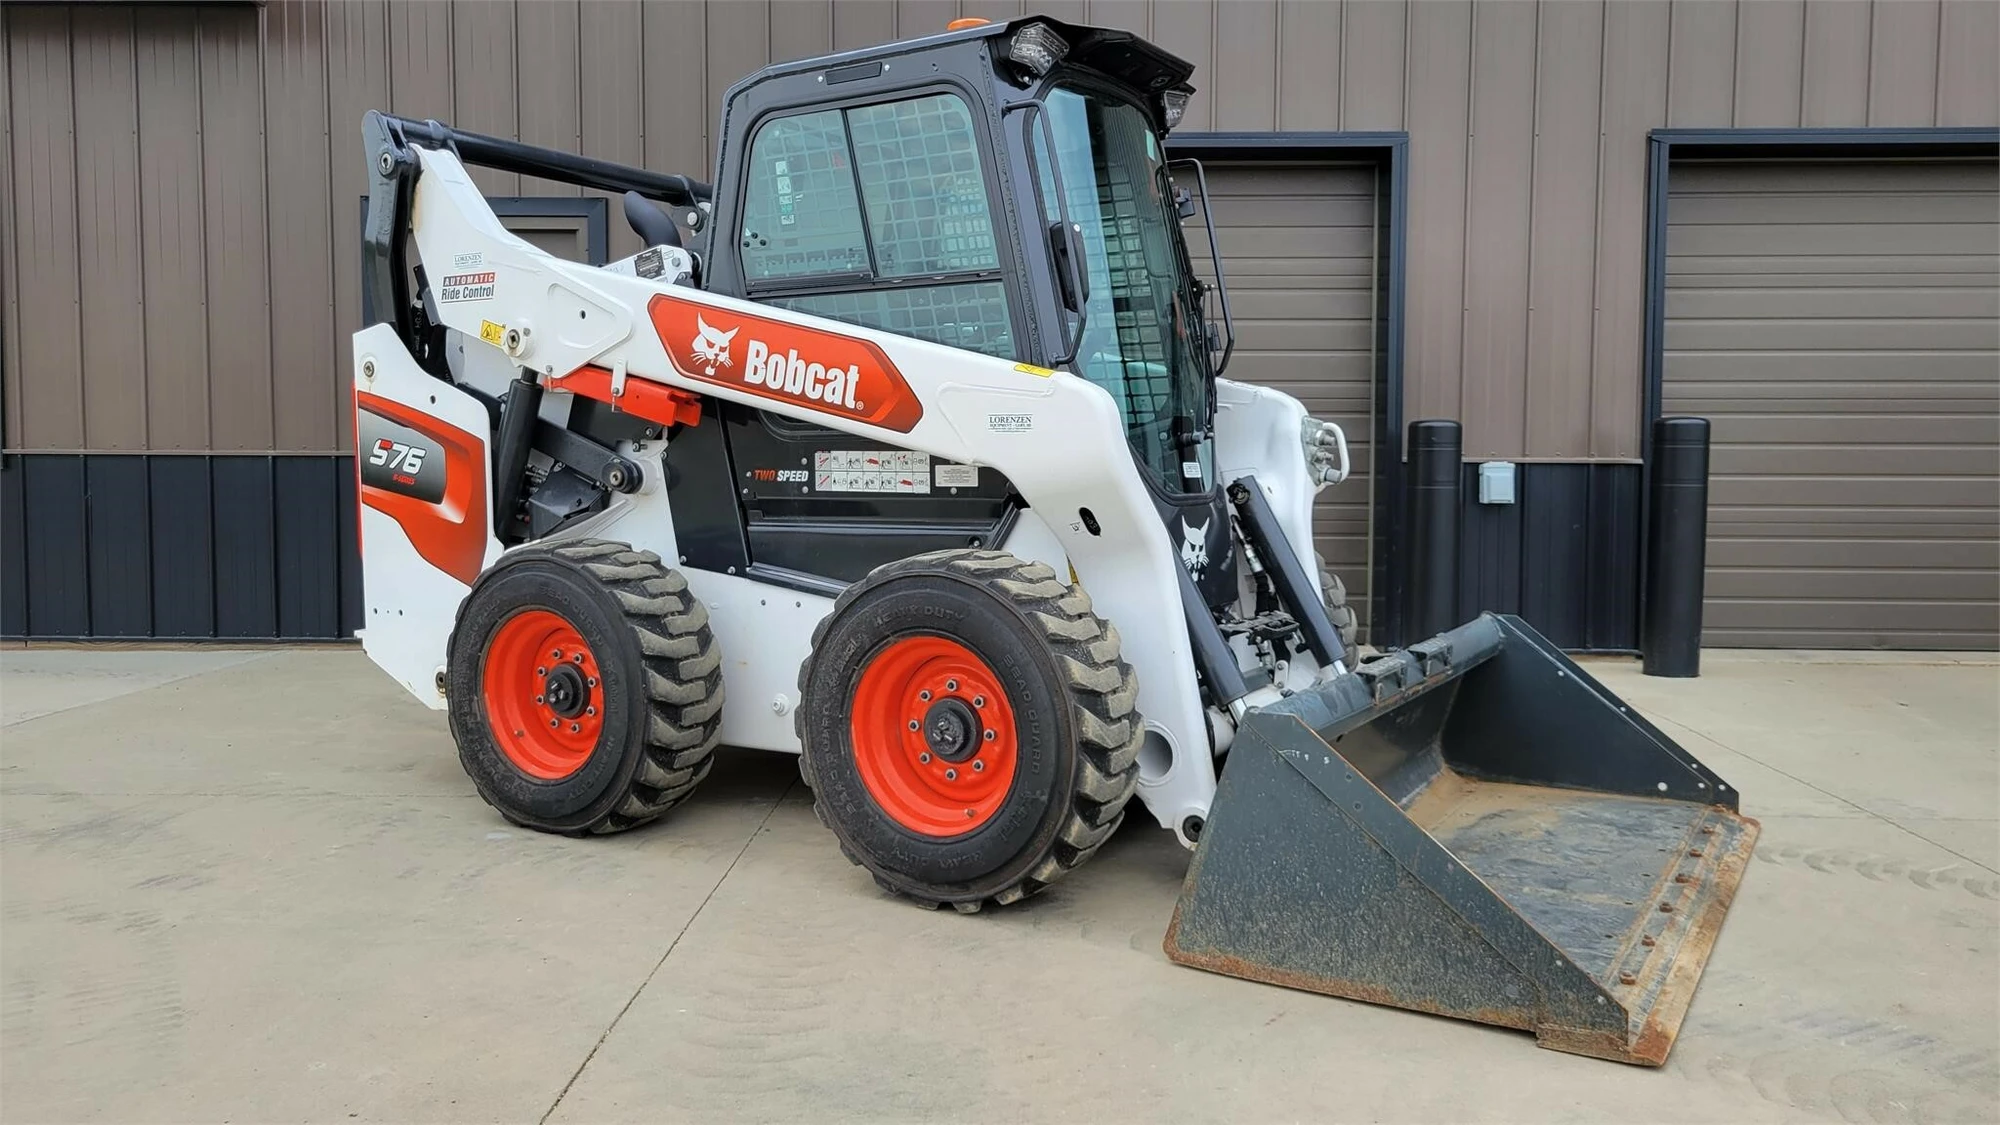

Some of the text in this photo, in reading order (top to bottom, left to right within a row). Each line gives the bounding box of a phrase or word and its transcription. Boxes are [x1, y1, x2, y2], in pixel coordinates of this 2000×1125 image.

[444, 274, 494, 286] AUTOMATIC
[441, 284, 495, 300] Ride Control
[369, 439, 426, 475] S76
[754, 470, 809, 482] TWO SPEED
